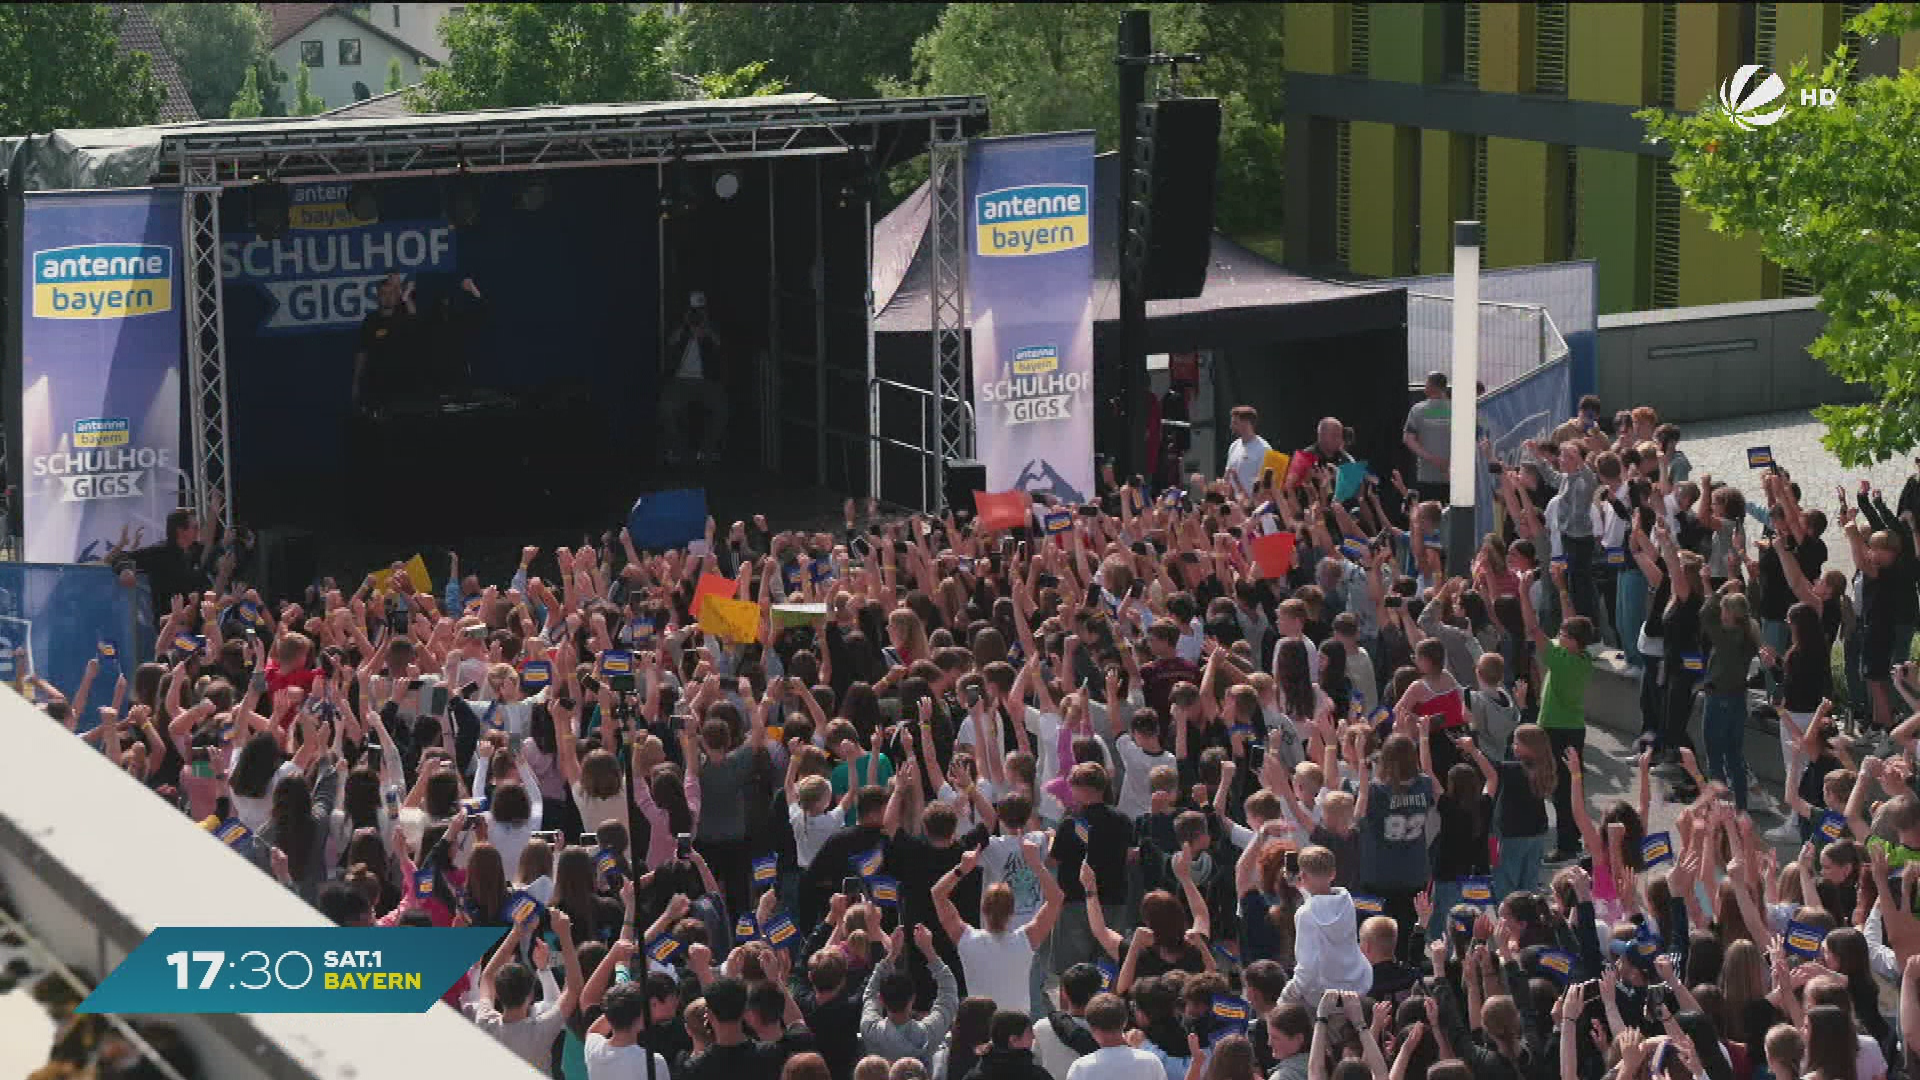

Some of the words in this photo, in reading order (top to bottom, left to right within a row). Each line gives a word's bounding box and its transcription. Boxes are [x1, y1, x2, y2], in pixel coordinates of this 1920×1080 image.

[296, 184, 352, 201] anten
[302, 208, 352, 226] baye
[984, 194, 1081, 219] antenne
[992, 225, 1074, 252] bayern
[222, 228, 449, 278] SCHULHOF
[42, 254, 163, 278] antenne
[52, 287, 153, 315] bayern
[982, 371, 1088, 401] SCHULHOF
[1014, 399, 1059, 420] GIGS
[33, 447, 169, 476] SCHULHOF
[73, 476, 130, 497] GIGS
